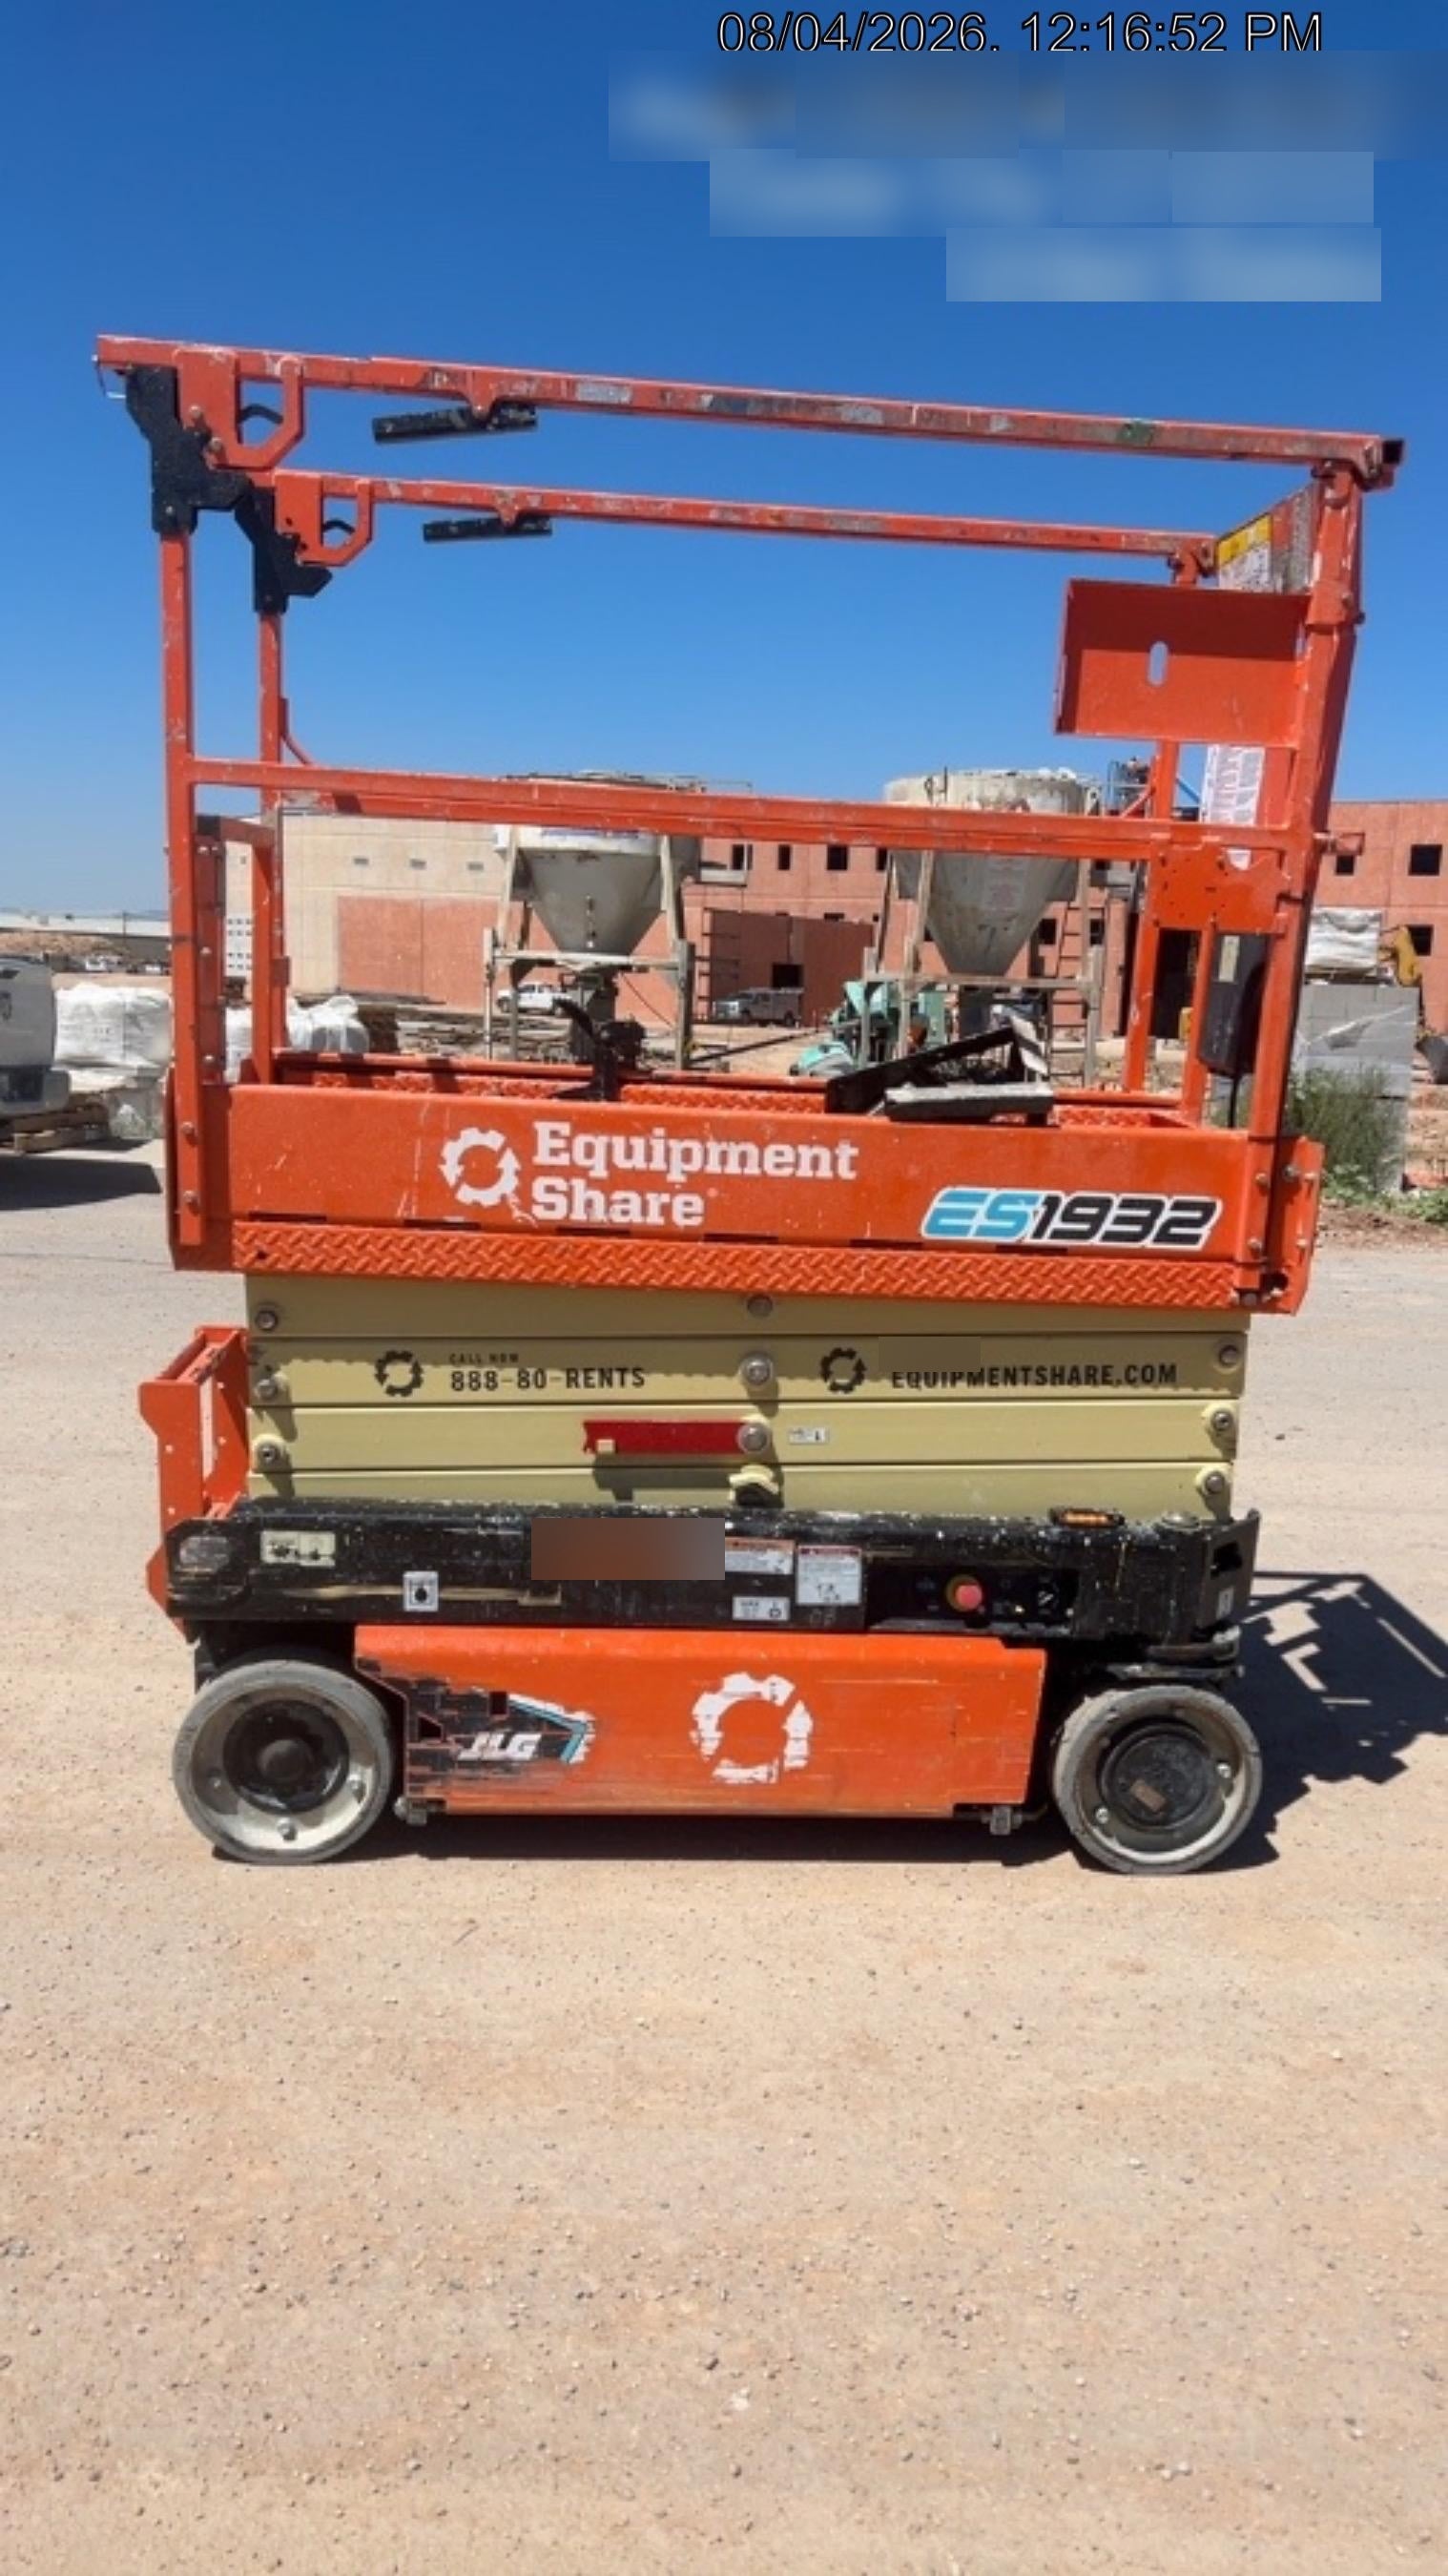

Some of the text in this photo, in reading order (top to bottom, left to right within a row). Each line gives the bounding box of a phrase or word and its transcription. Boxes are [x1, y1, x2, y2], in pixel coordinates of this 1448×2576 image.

[532, 1120, 858, 1181] Equipment
[530, 1175, 705, 1227] Share
[922, 1187, 1222, 1250] ES1932
[449, 1352, 519, 1364] CALL NOW
[451, 1367, 645, 1392] 888-80-RENTS
[891, 1362, 1178, 1391] EQUIPMENTSHARE.COM
[457, 1731, 542, 1761] JLG
